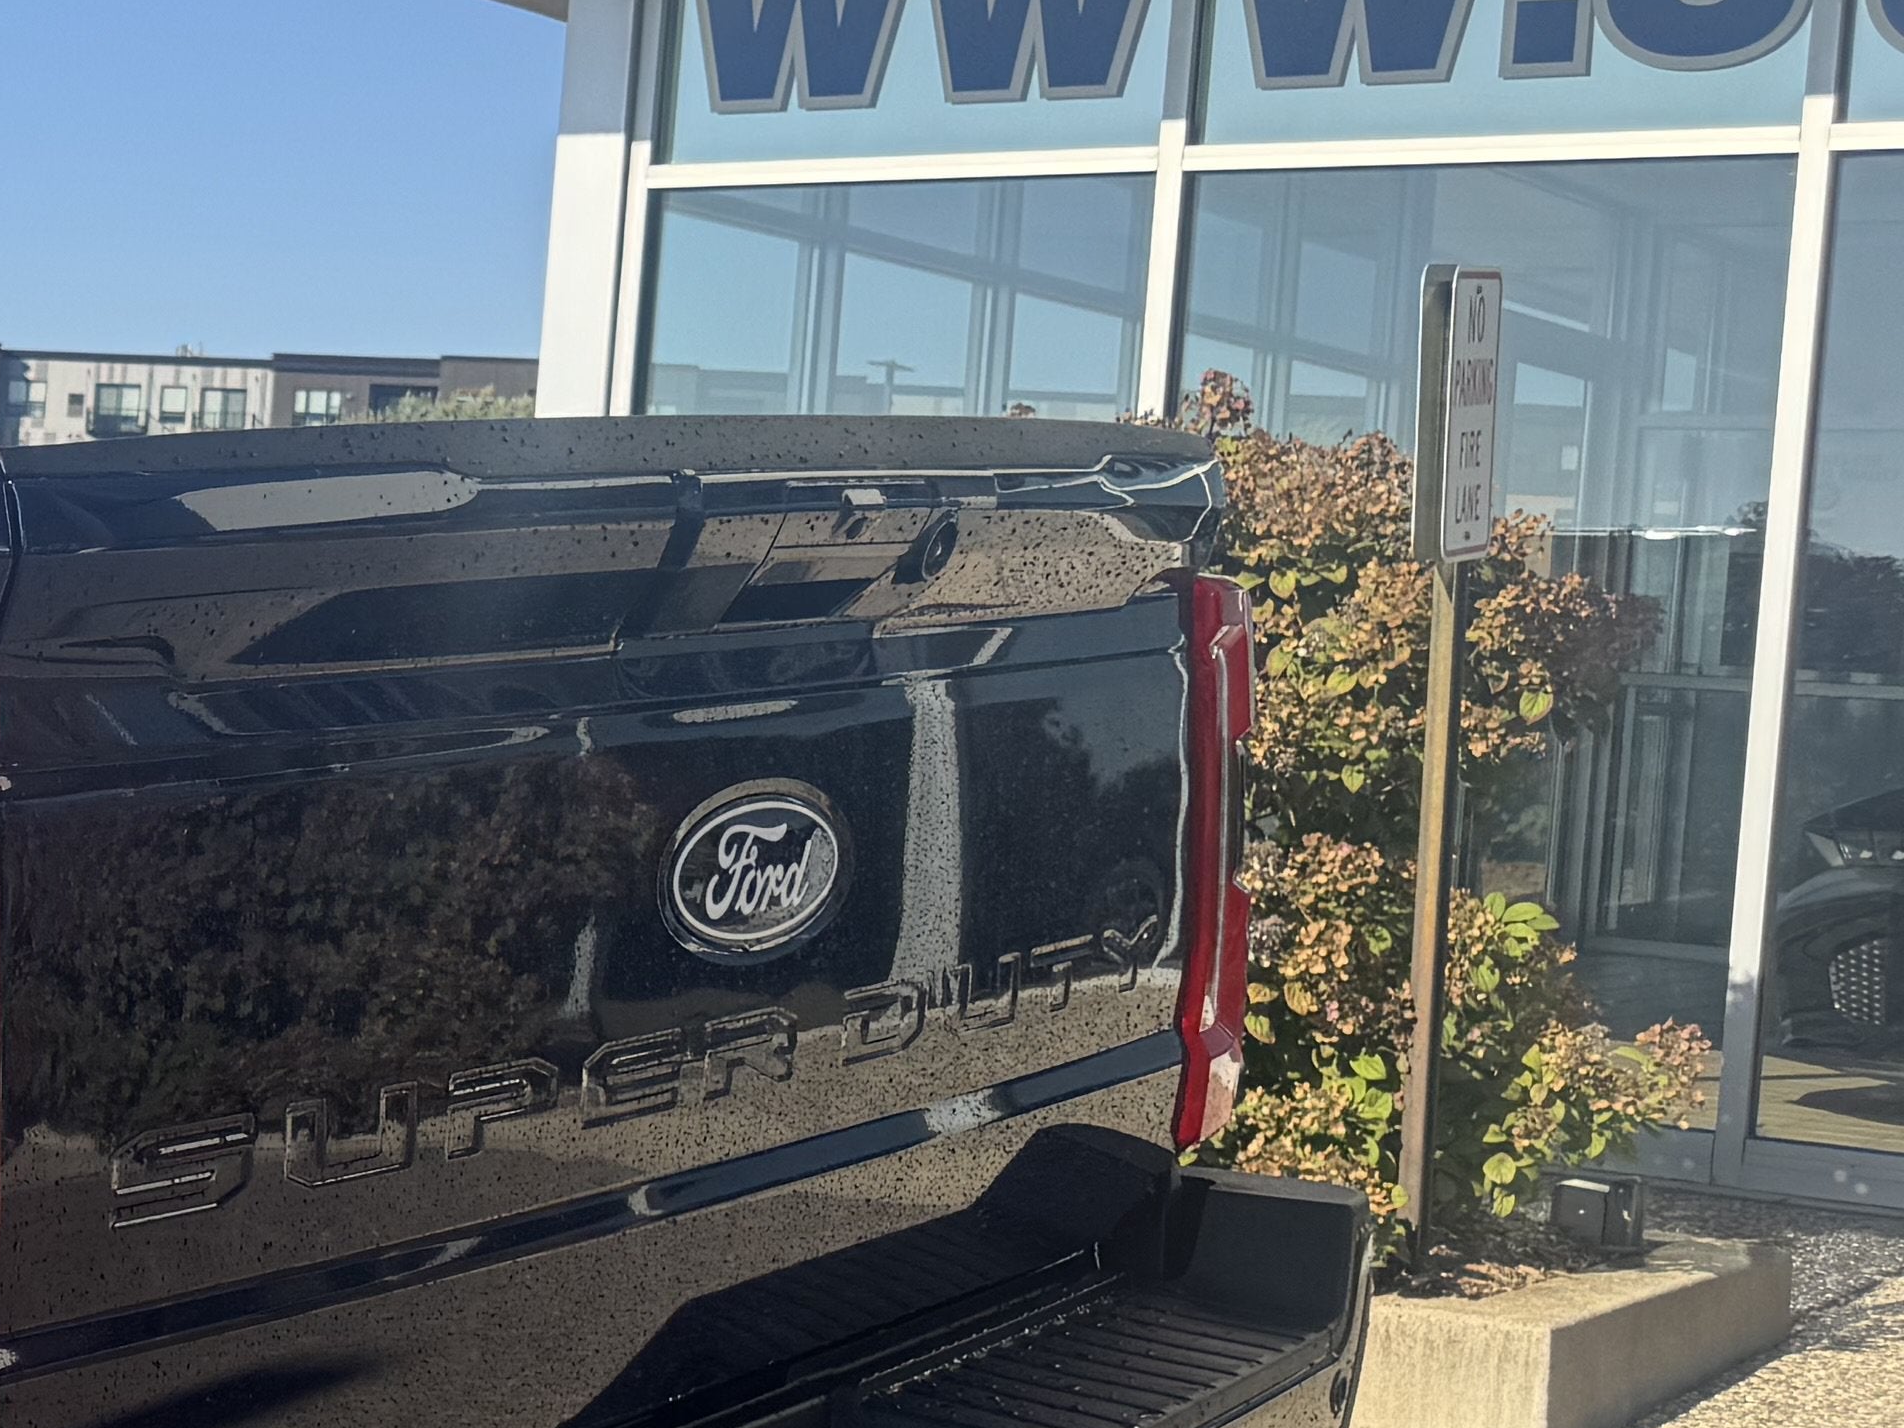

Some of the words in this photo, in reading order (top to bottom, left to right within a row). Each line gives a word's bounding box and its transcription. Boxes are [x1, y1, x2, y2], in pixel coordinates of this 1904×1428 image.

[1467, 294, 1487, 345] NO
[1453, 358, 1494, 408] PARKING
[1459, 429, 1482, 469] FIRE
[1454, 483, 1482, 524] LANE
[705, 822, 812, 920] Ford
[109, 1006, 798, 1232] SUPER
[840, 914, 1160, 1066] DUTY
